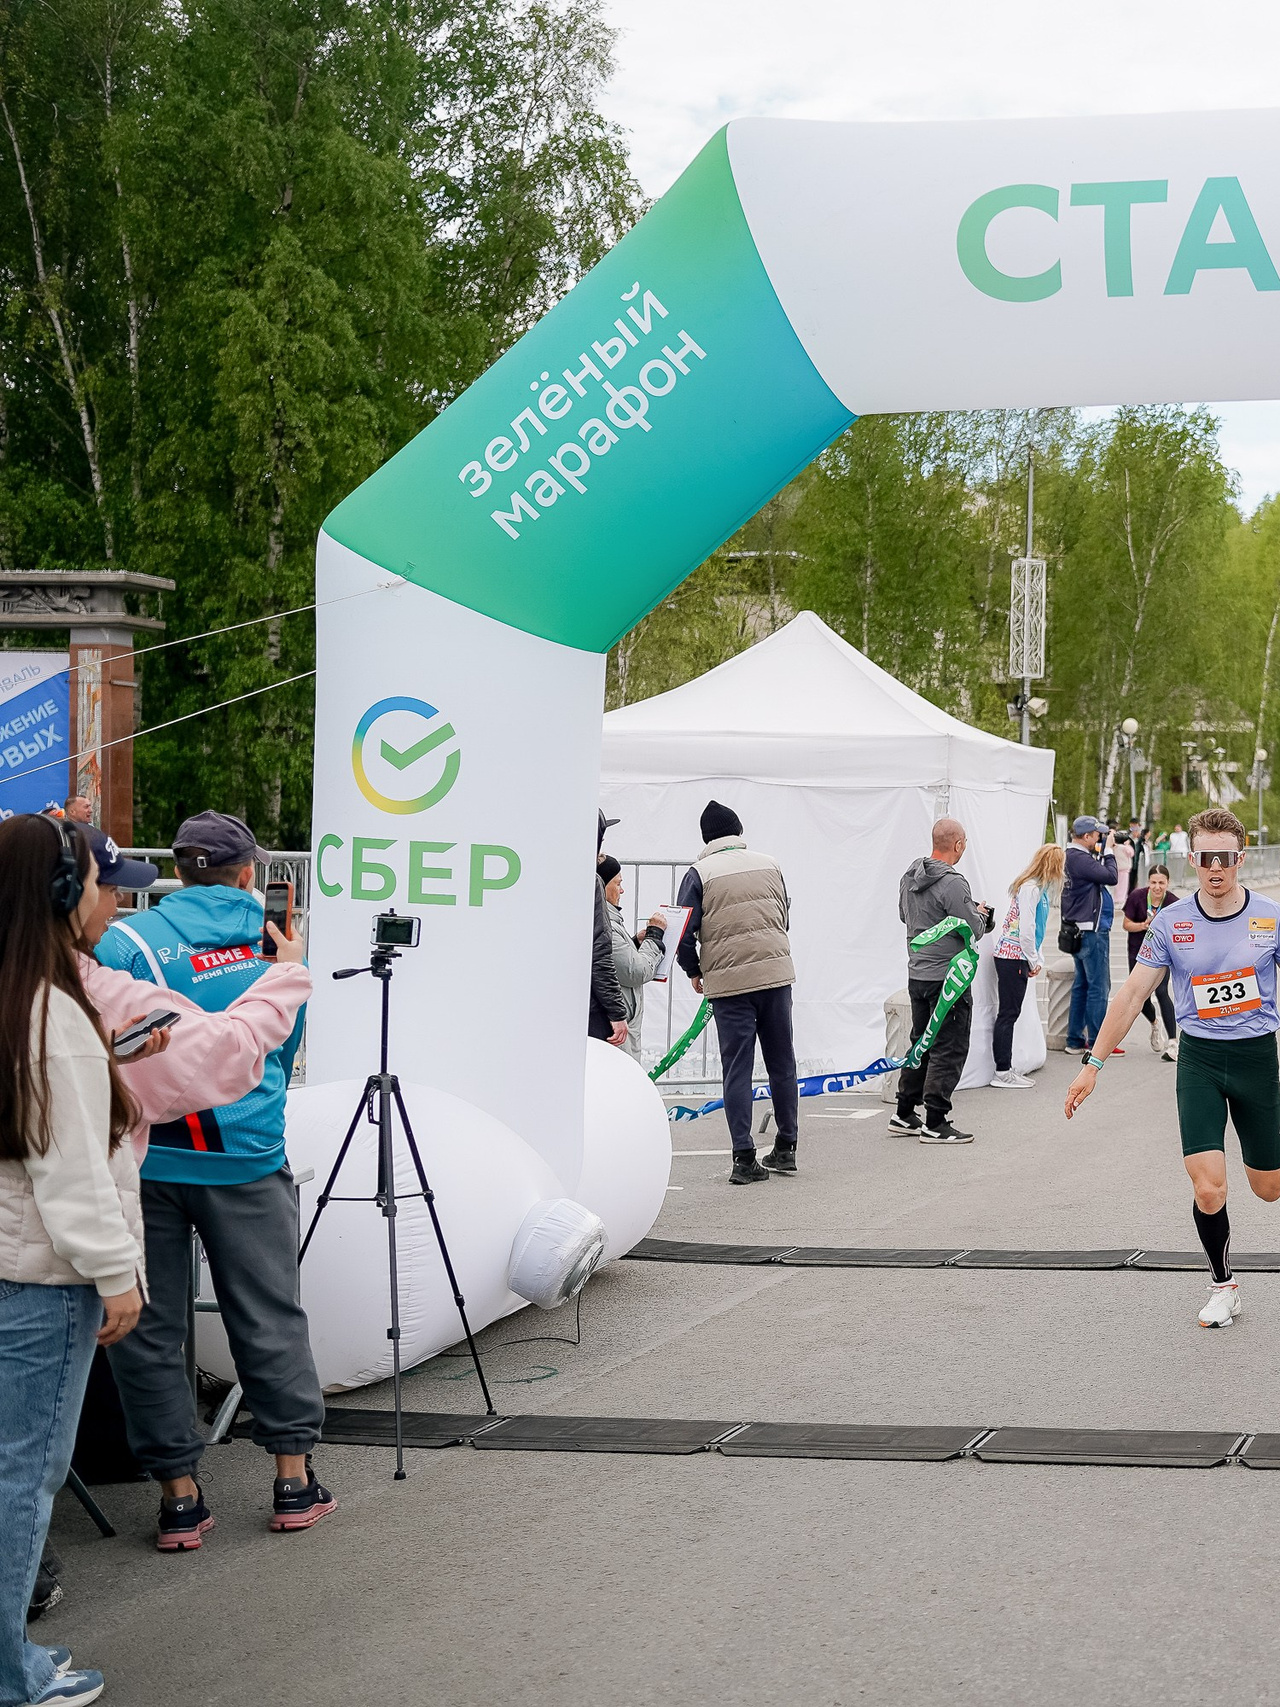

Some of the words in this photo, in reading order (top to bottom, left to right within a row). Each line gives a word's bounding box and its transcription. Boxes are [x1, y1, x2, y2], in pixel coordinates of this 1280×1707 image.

[458, 281, 670, 498] зелёный
[490, 329, 707, 540] марафон
[317, 833, 522, 907] СБЕР
[191, 969, 223, 984] ВРЕМЯ
[198, 947, 245, 968] TIME
[1207, 982, 1246, 1004] 233
